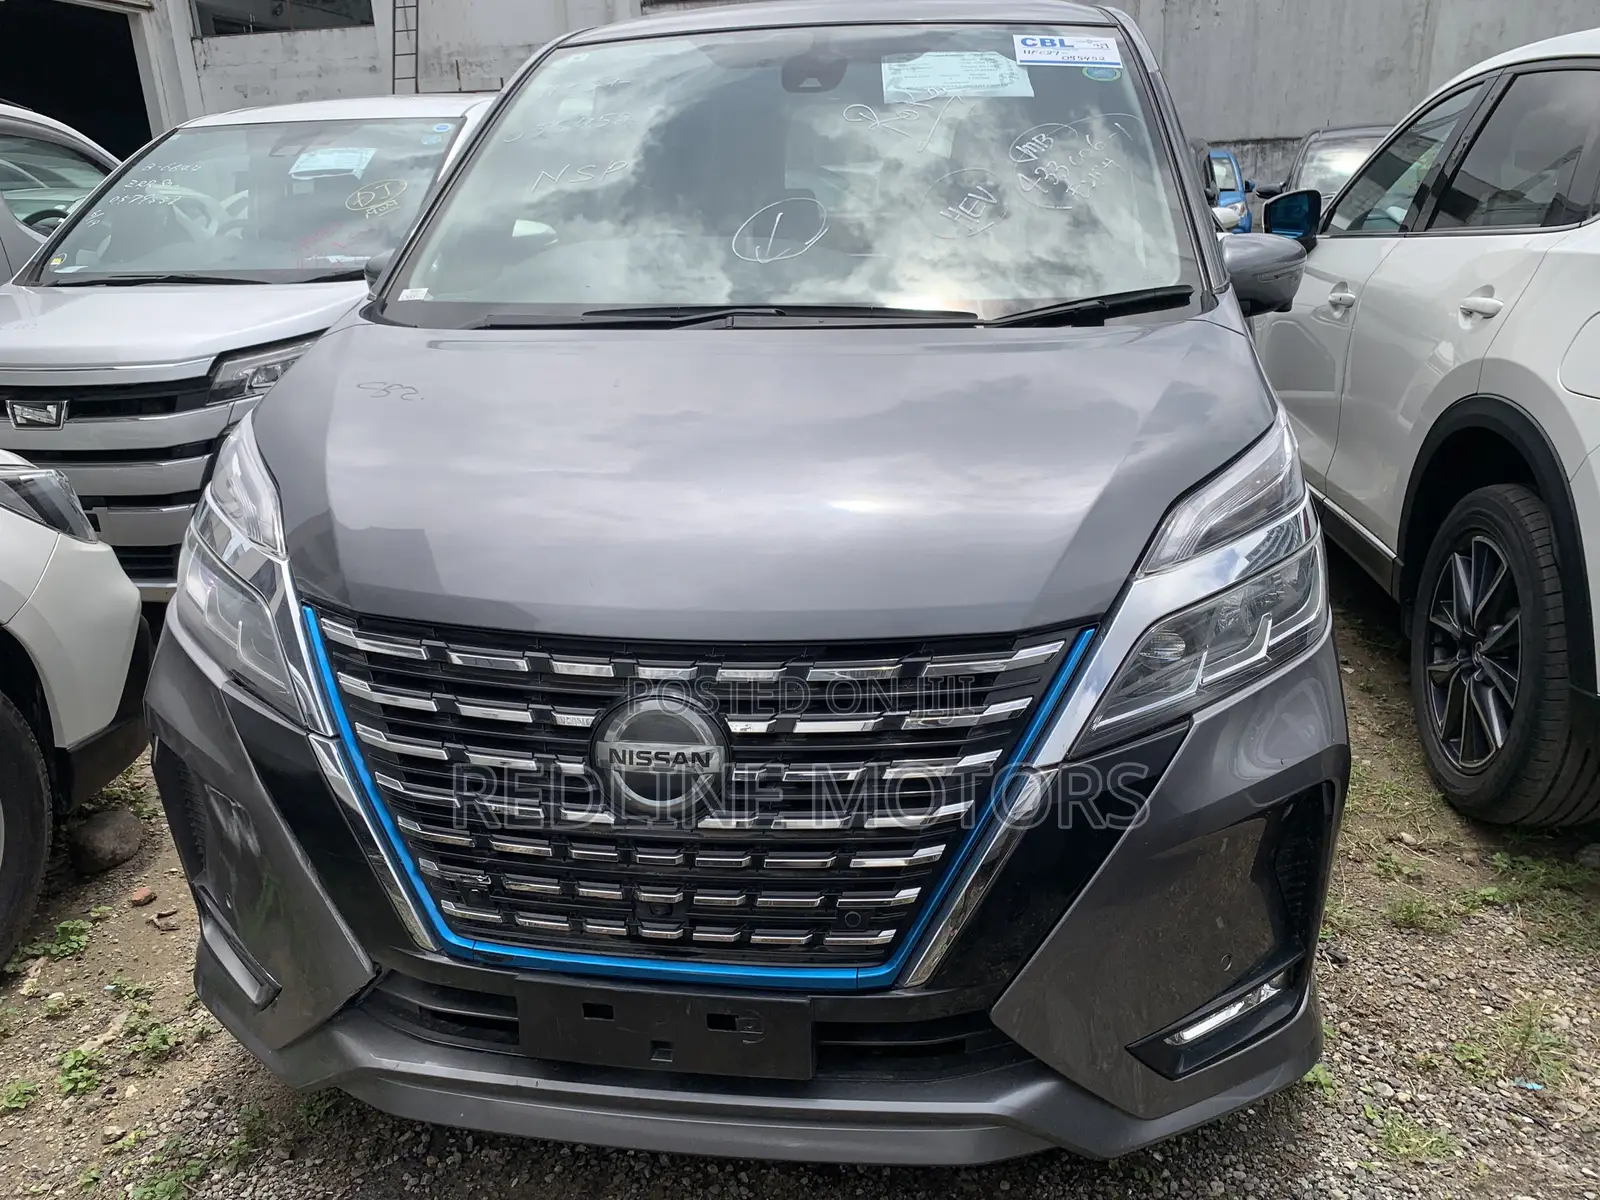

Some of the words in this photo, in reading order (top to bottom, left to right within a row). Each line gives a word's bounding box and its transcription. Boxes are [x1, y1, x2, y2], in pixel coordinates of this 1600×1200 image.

[1020, 37, 1075, 48] CBL
[531, 160, 629, 193] NSP
[608, 748, 711, 768] NISSAN
